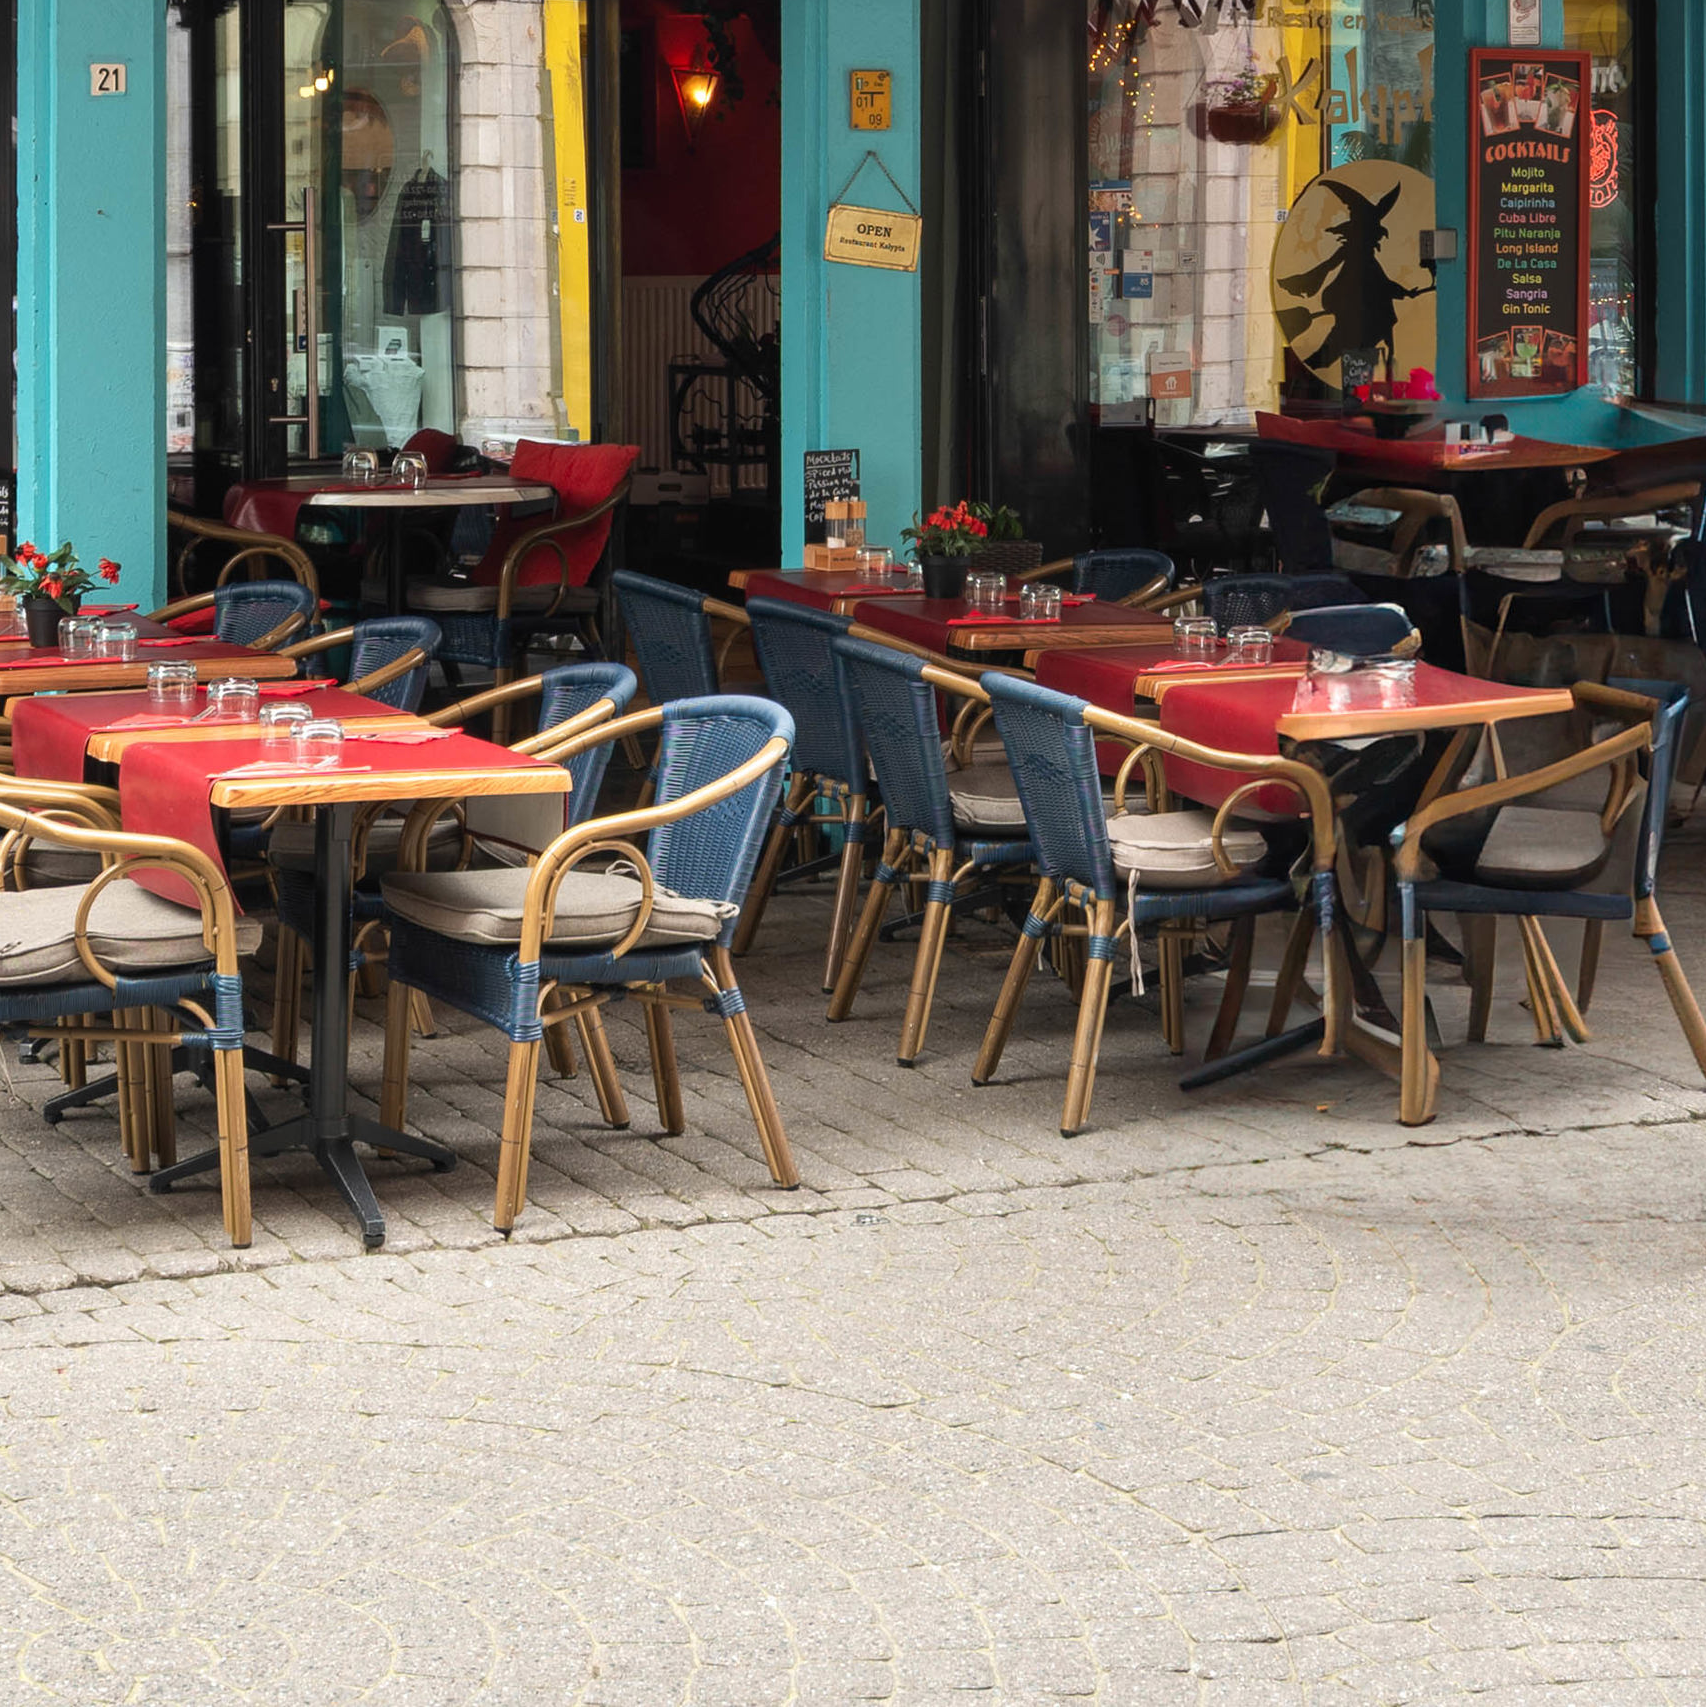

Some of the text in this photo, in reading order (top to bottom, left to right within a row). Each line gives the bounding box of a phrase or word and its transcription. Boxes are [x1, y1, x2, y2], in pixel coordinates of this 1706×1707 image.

[1343, 13, 1369, 31] en
[97, 67, 123, 93] 21
[1485, 141, 1571, 163] COCKTAILS
[1511, 166, 1545, 180] Mojito
[1501, 181, 1555, 196] Margarita
[1500, 197, 1556, 210] Caipirinha
[1498, 212, 1557, 224] Cuba Libre
[856, 223, 893, 239] OPEN
[1494, 227, 1561, 240] Pitu Naranja
[839, 236, 878, 249] Restaurant
[1495, 243, 1559, 255] Long Island
[1497, 258, 1557, 270] De La Casa
[1512, 273, 1543, 285] Salsa
[1506, 288, 1548, 301] Sangria
[1502, 303, 1551, 315] Gin Tonic
